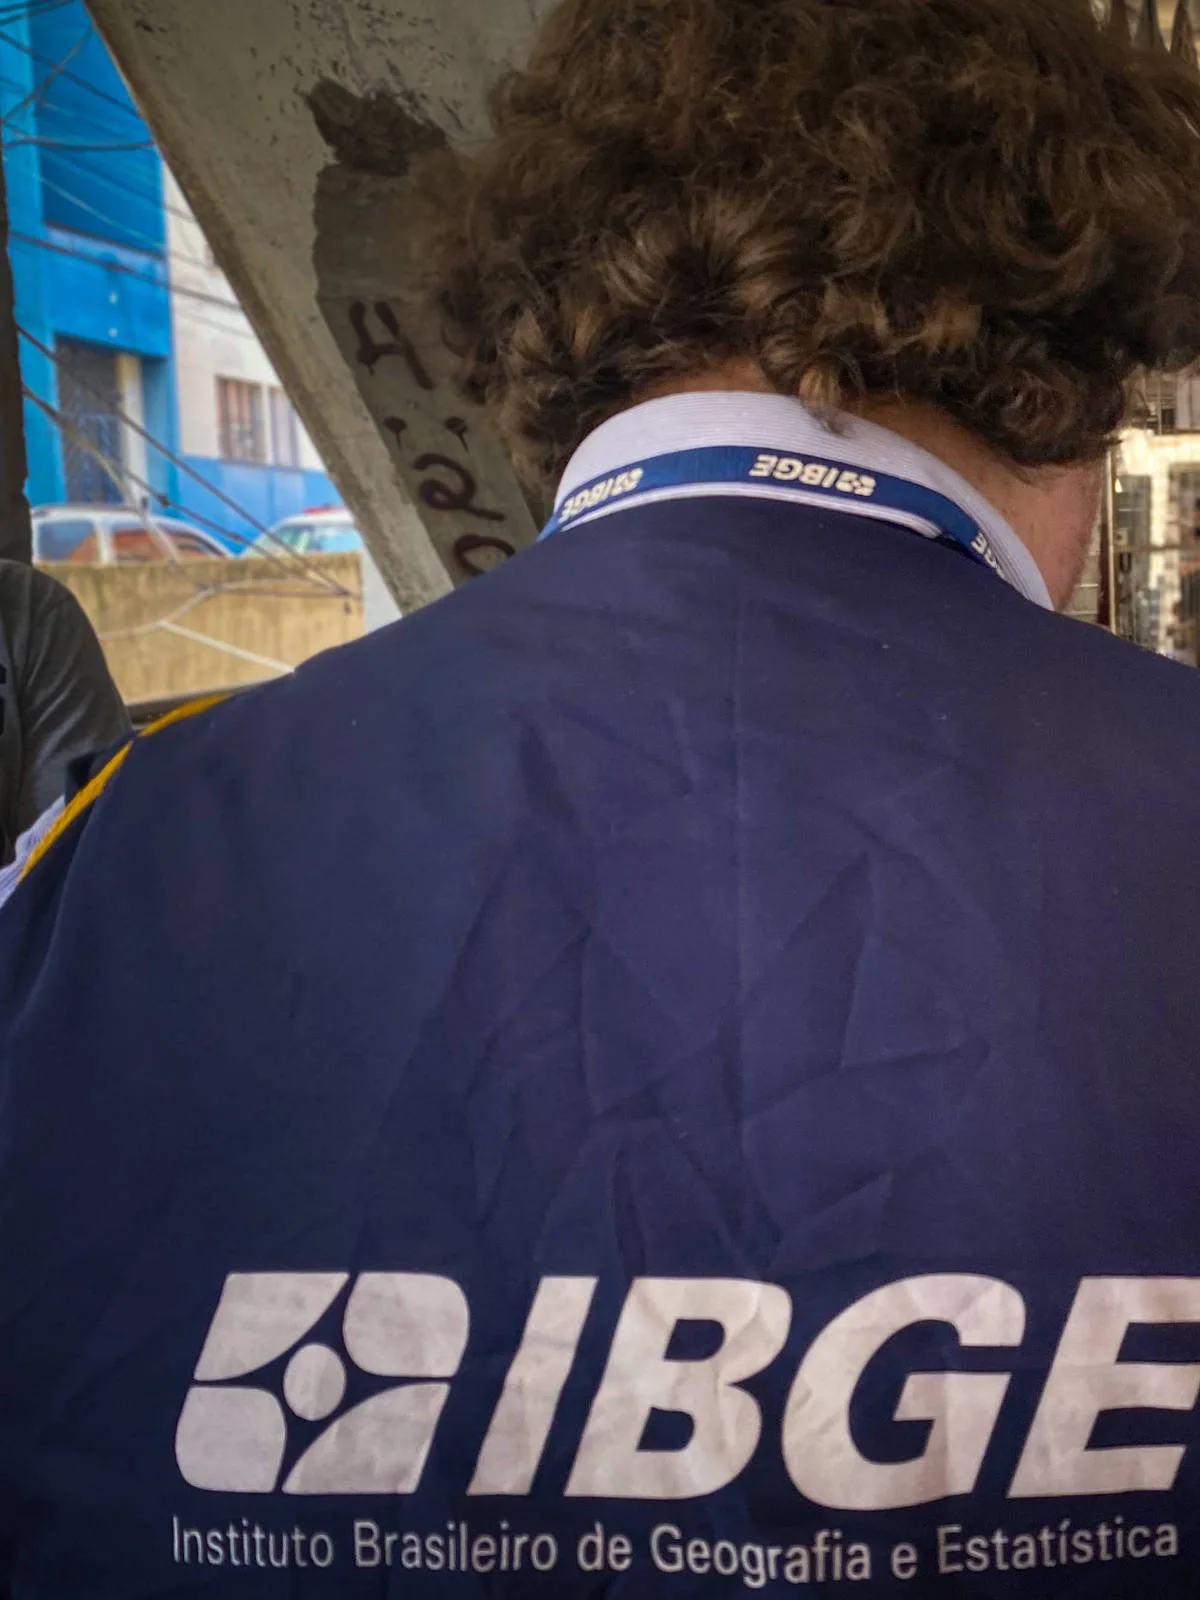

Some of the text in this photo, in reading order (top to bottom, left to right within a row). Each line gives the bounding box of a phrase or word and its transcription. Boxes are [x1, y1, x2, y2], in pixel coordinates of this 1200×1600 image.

[748, 454, 840, 489] IBGE
[172, 1515, 1178, 1589] Instituto Brasileiro de Geografia e Estatística
